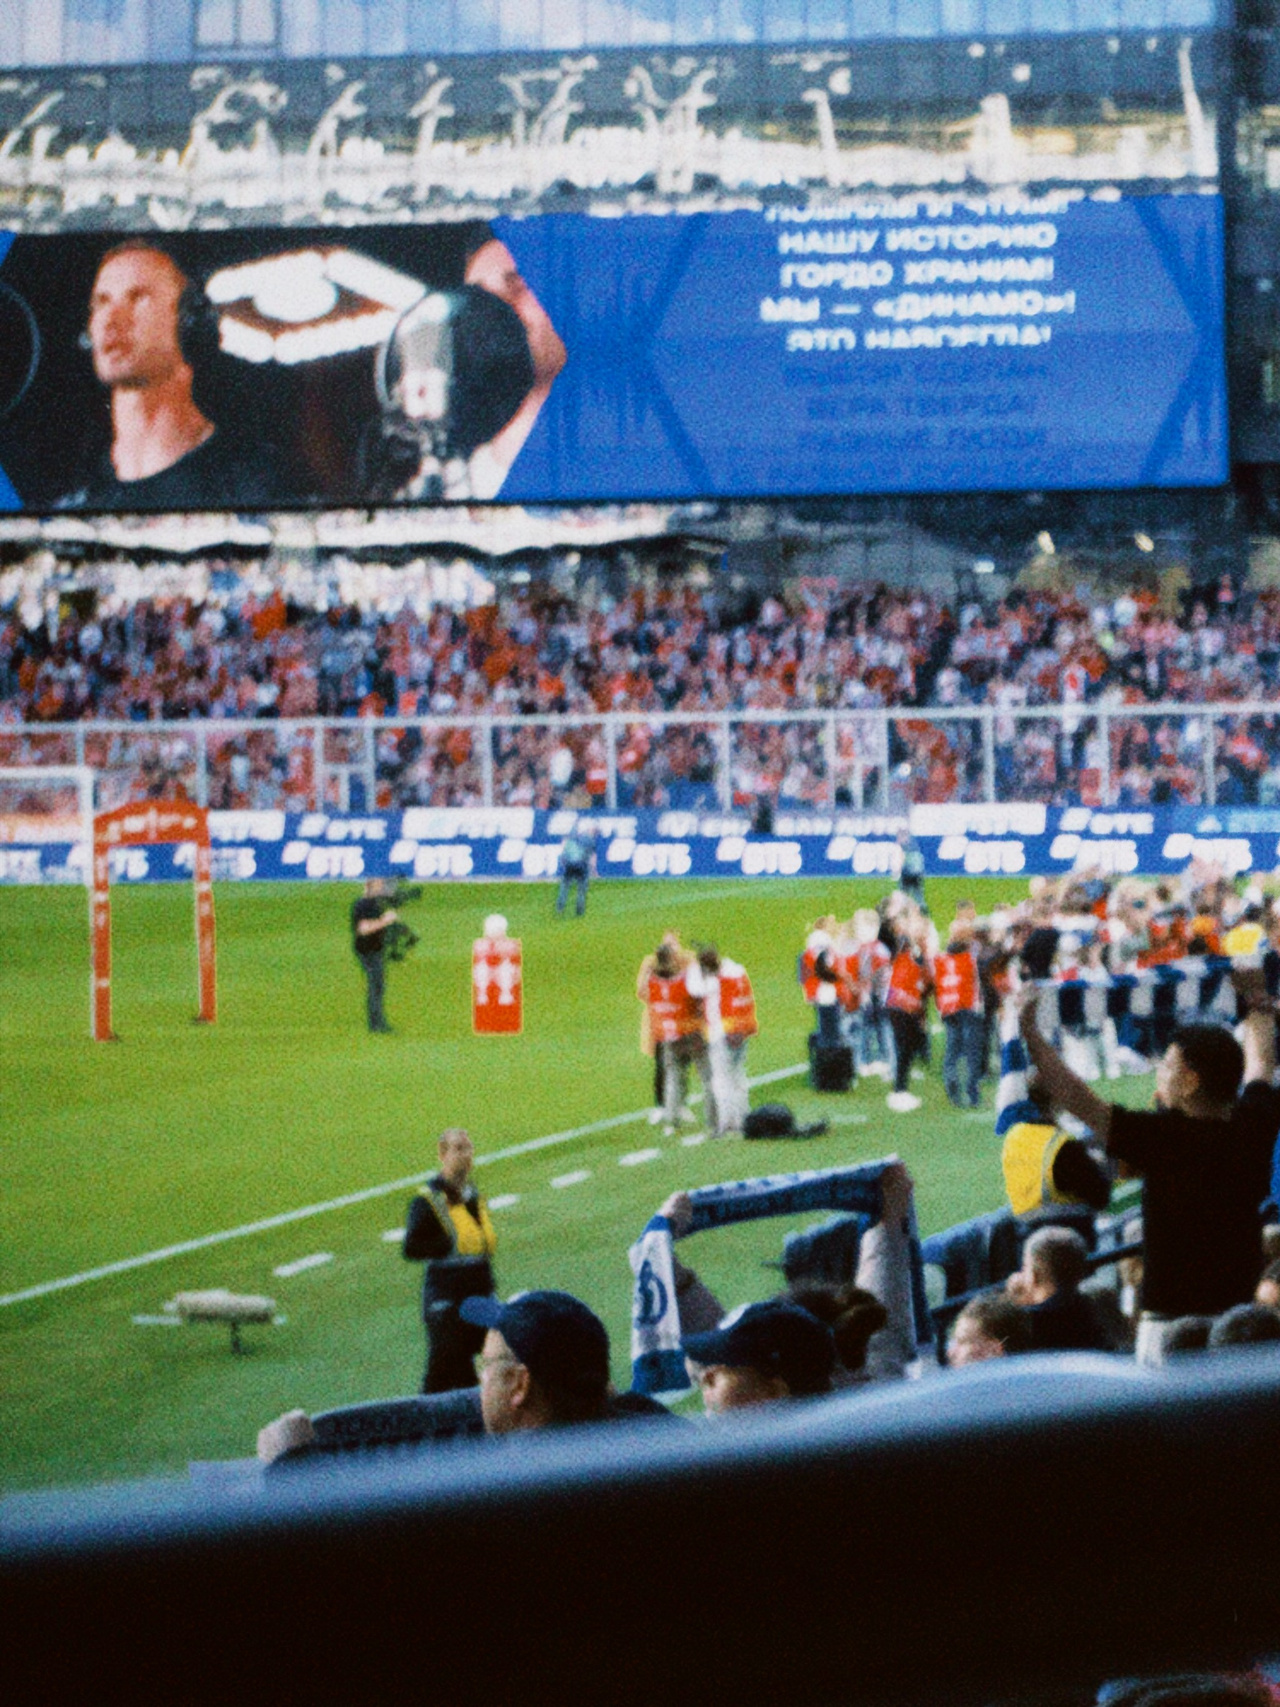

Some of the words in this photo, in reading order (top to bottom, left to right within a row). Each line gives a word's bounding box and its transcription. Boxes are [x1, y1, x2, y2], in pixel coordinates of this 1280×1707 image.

[778, 230, 879, 254] НАШУ
[886, 221, 1058, 251] ИСТОРИЮ
[779, 259, 894, 289] ГОРДО
[903, 256, 1054, 285] ХРАНИМ!
[760, 296, 820, 322] МЫ
